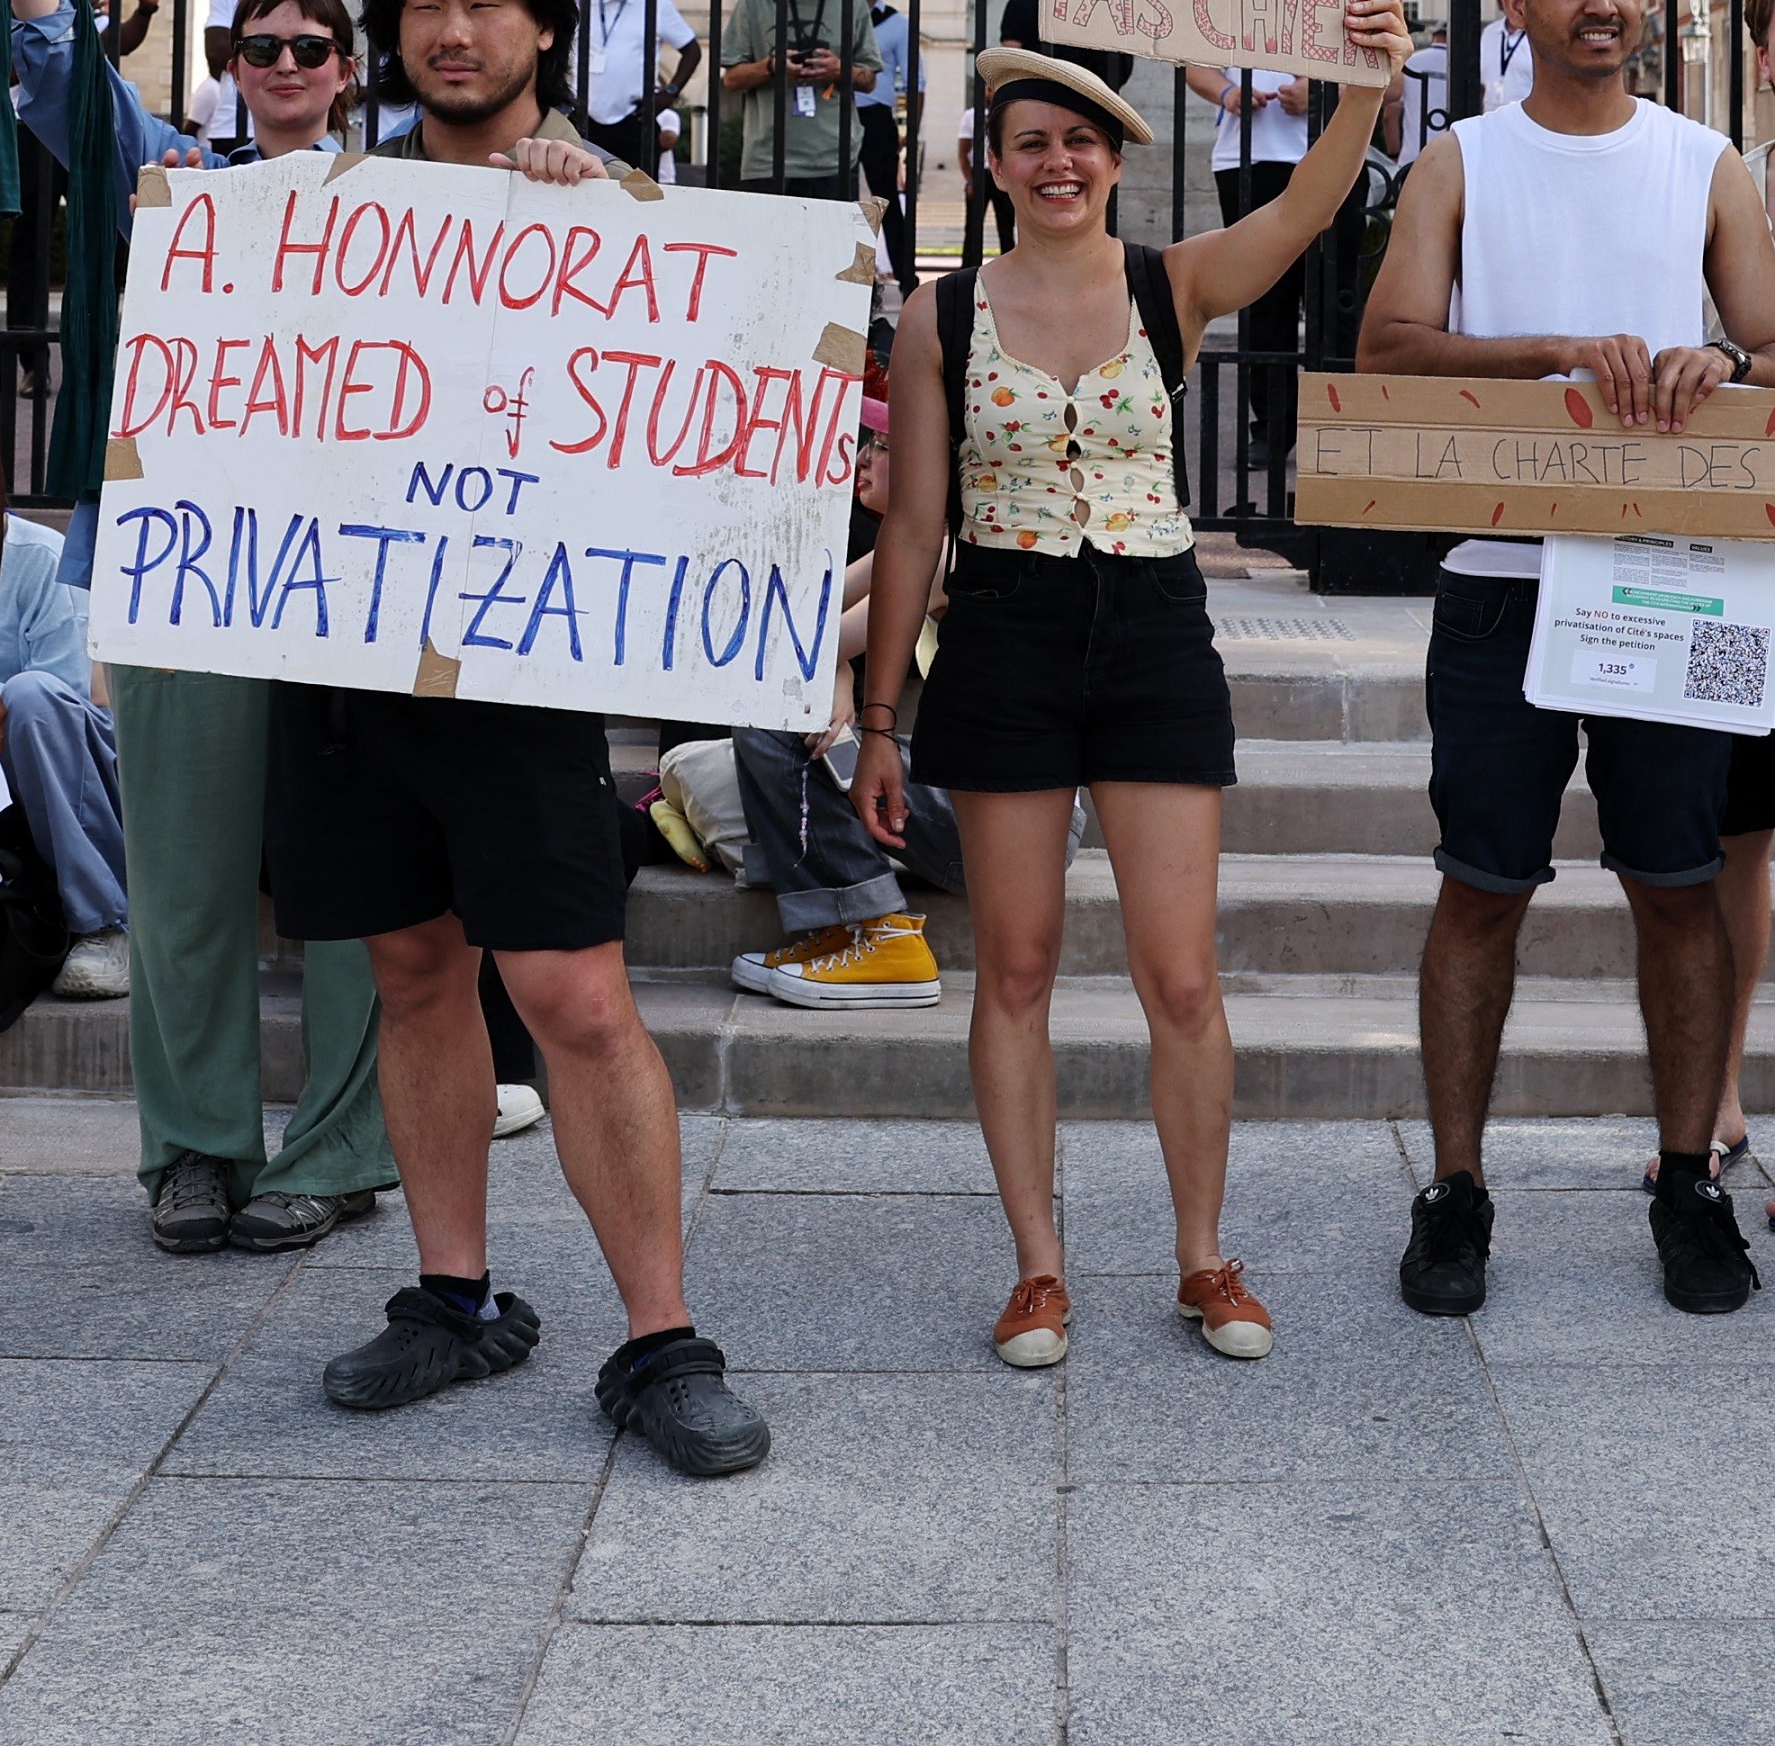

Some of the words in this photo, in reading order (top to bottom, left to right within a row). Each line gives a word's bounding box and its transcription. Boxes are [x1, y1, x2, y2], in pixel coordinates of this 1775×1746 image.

[161, 192, 236, 295] A.
[270, 188, 739, 324] HONNORAT
[110, 332, 430, 442] DREAMED
[482, 365, 537, 460] of
[1315, 427, 1382, 479] ET
[1413, 431, 1463, 481] LA
[1491, 437, 1648, 485] CHARTE
[1678, 444, 1763, 490] DES
[406, 461, 540, 515] NOT
[116, 499, 833, 683] PRIVATIZATION
[1576, 607, 1592, 618] Say
[1593, 610, 1609, 619] NO
[1611, 613, 1620, 621] to
[1622, 615, 1666, 626] excessive
[1554, 618, 1613, 633] privatisation
[1615, 624, 1625, 634] of
[1653, 632, 1685, 642] spaces
[1580, 634, 1600, 645] Sign
[1601, 636, 1617, 646] the
[1618, 639, 1656, 651] petition
[1598, 662, 1627, 675] 1,335
